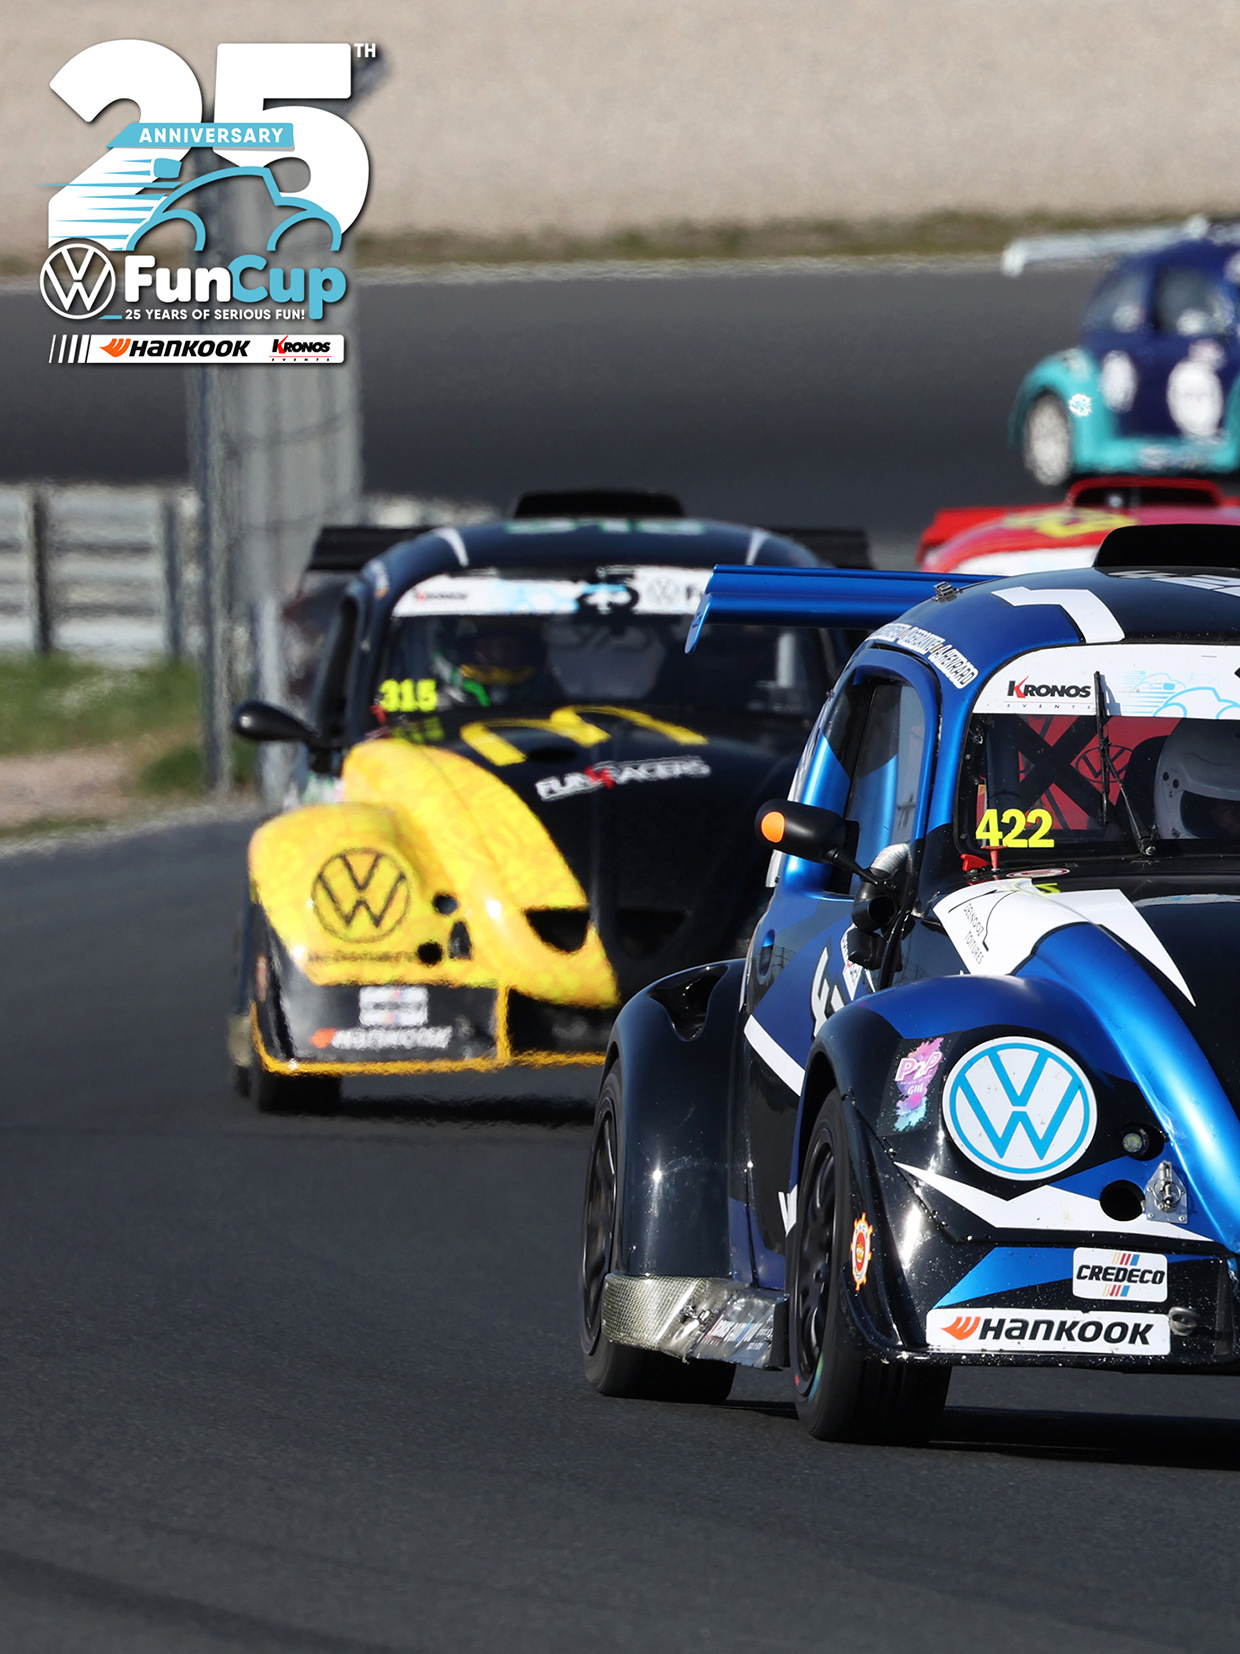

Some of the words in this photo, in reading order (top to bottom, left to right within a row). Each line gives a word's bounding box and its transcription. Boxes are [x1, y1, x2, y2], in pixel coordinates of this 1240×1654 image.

[379, 679, 438, 712] 315
[1007, 676, 1092, 699] KRONOS
[976, 808, 1055, 848] 422
[1076, 1264, 1166, 1285] CREDECO
